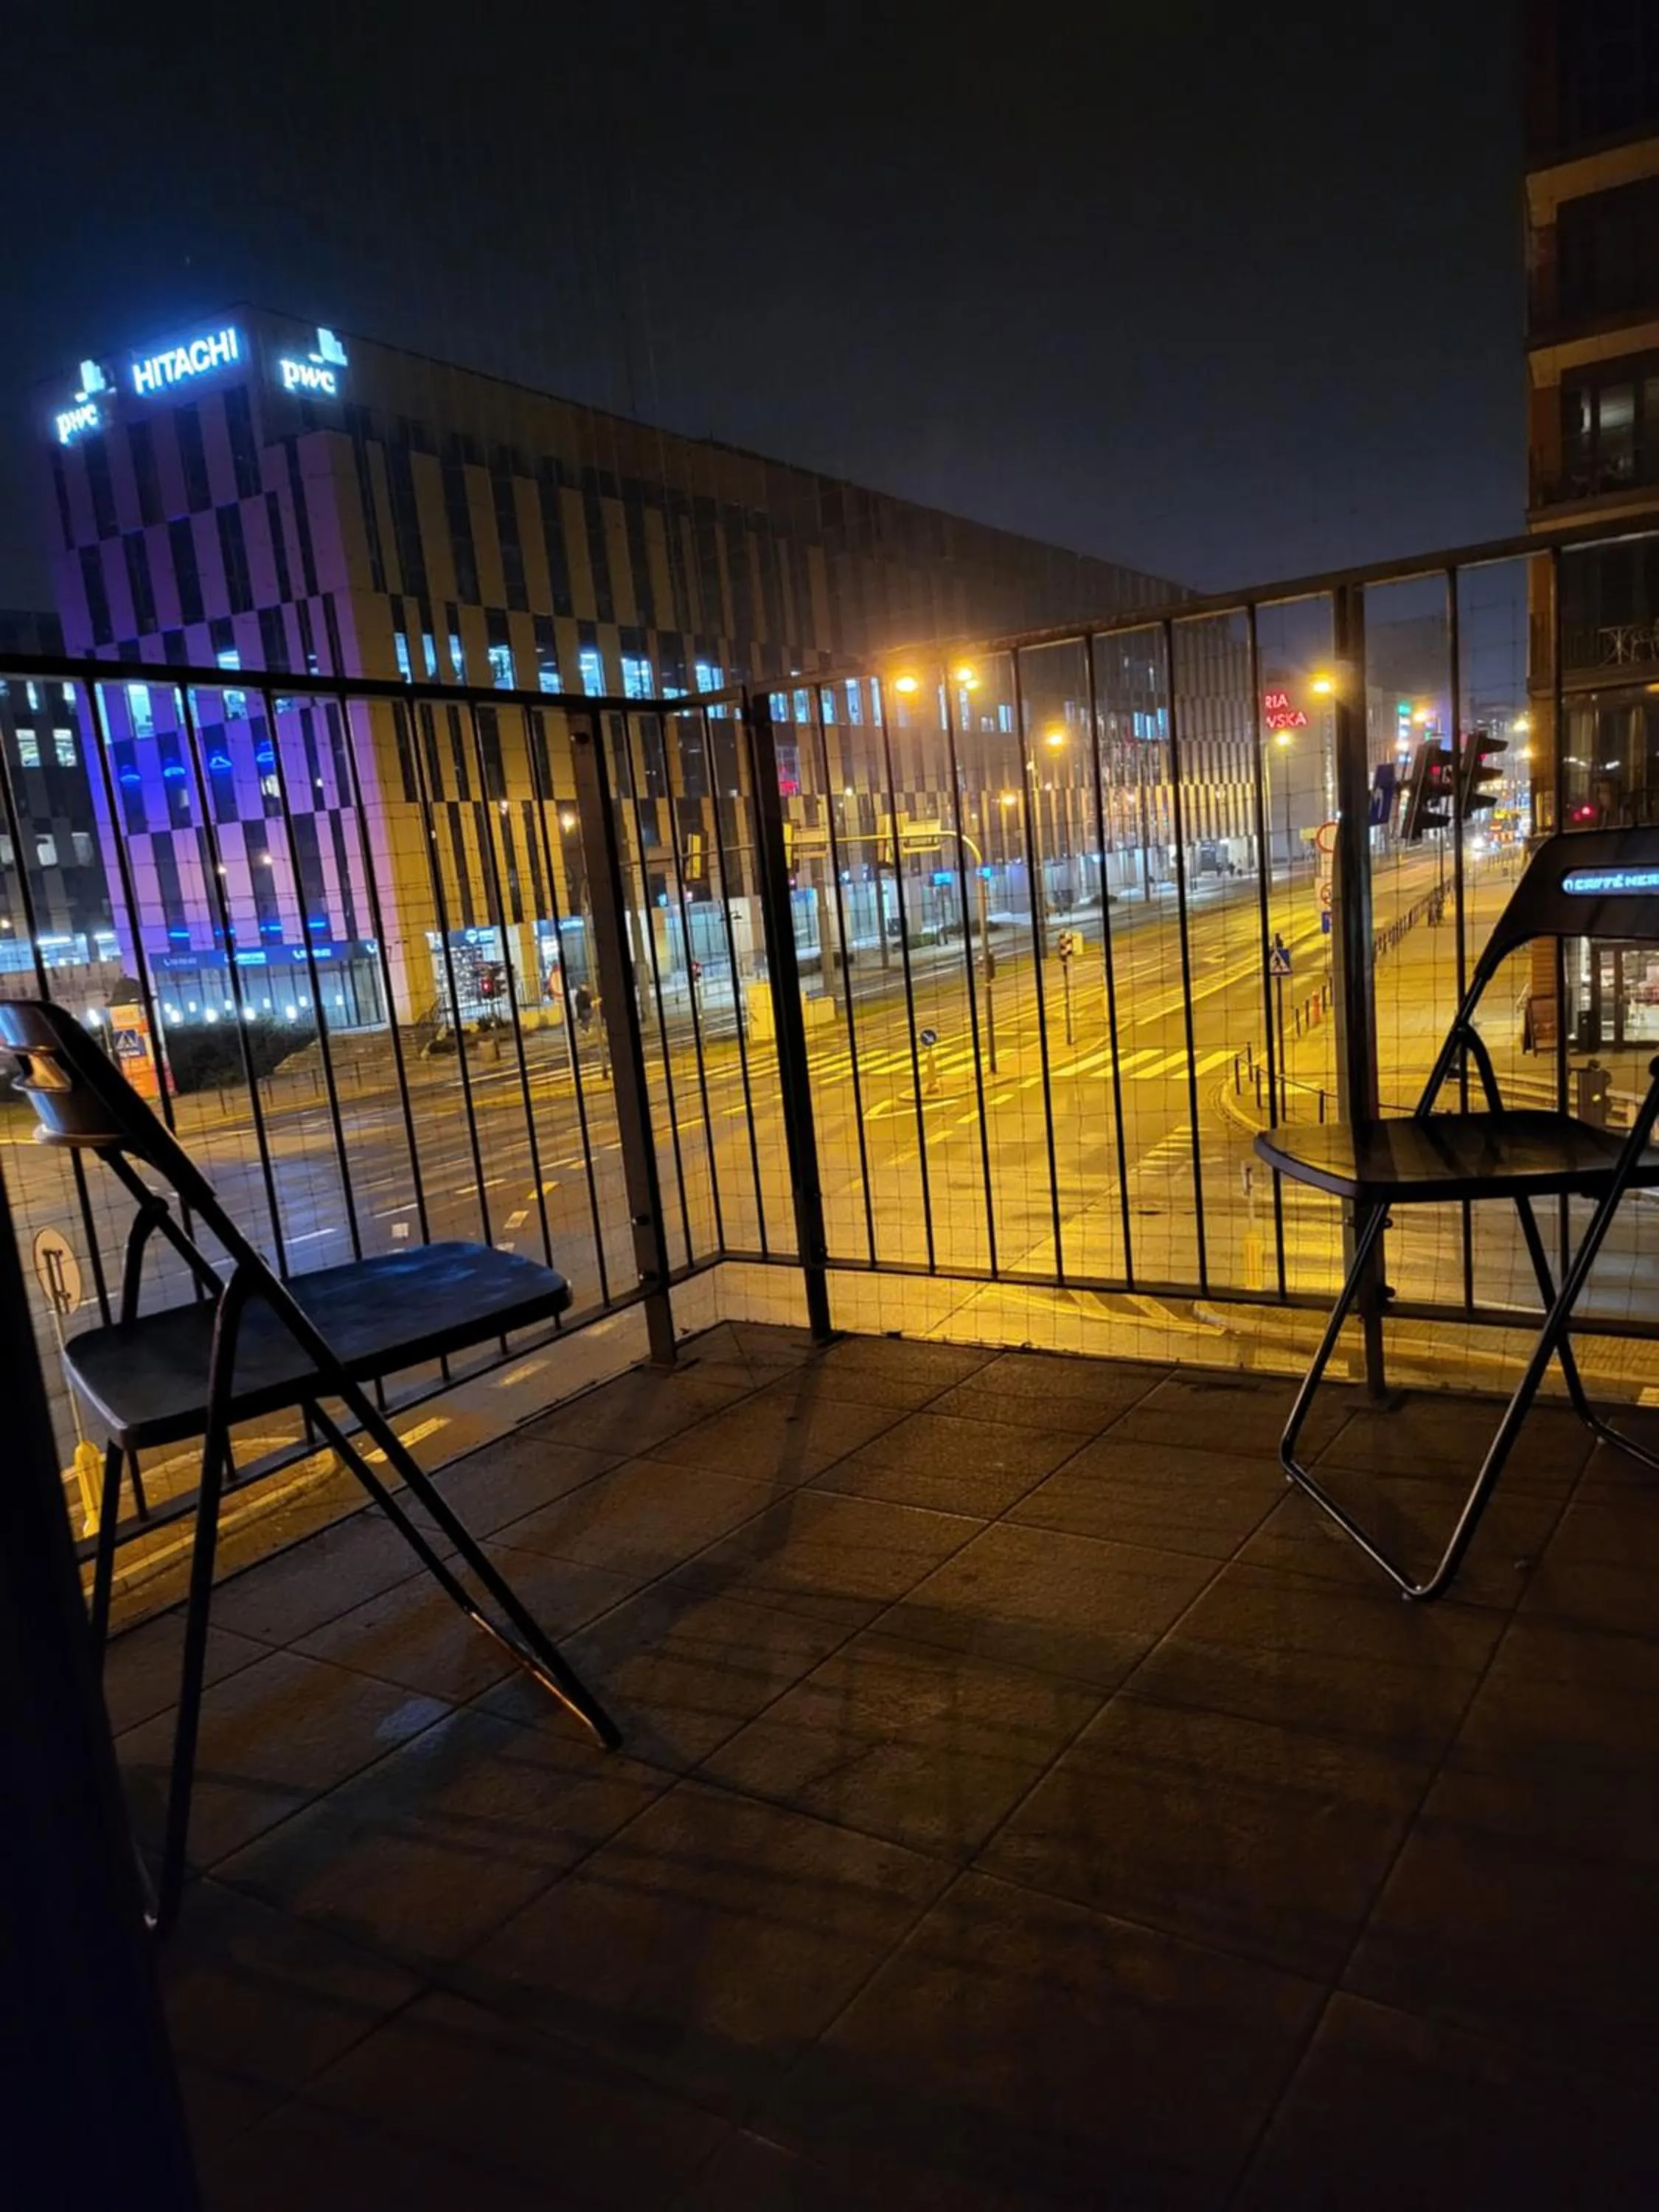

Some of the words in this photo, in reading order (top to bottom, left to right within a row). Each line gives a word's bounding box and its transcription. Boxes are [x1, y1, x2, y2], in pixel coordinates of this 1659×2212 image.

[133, 327, 238, 394] HITACHI
[280, 359, 335, 394] pwc
[56, 404, 97, 444] pwc
